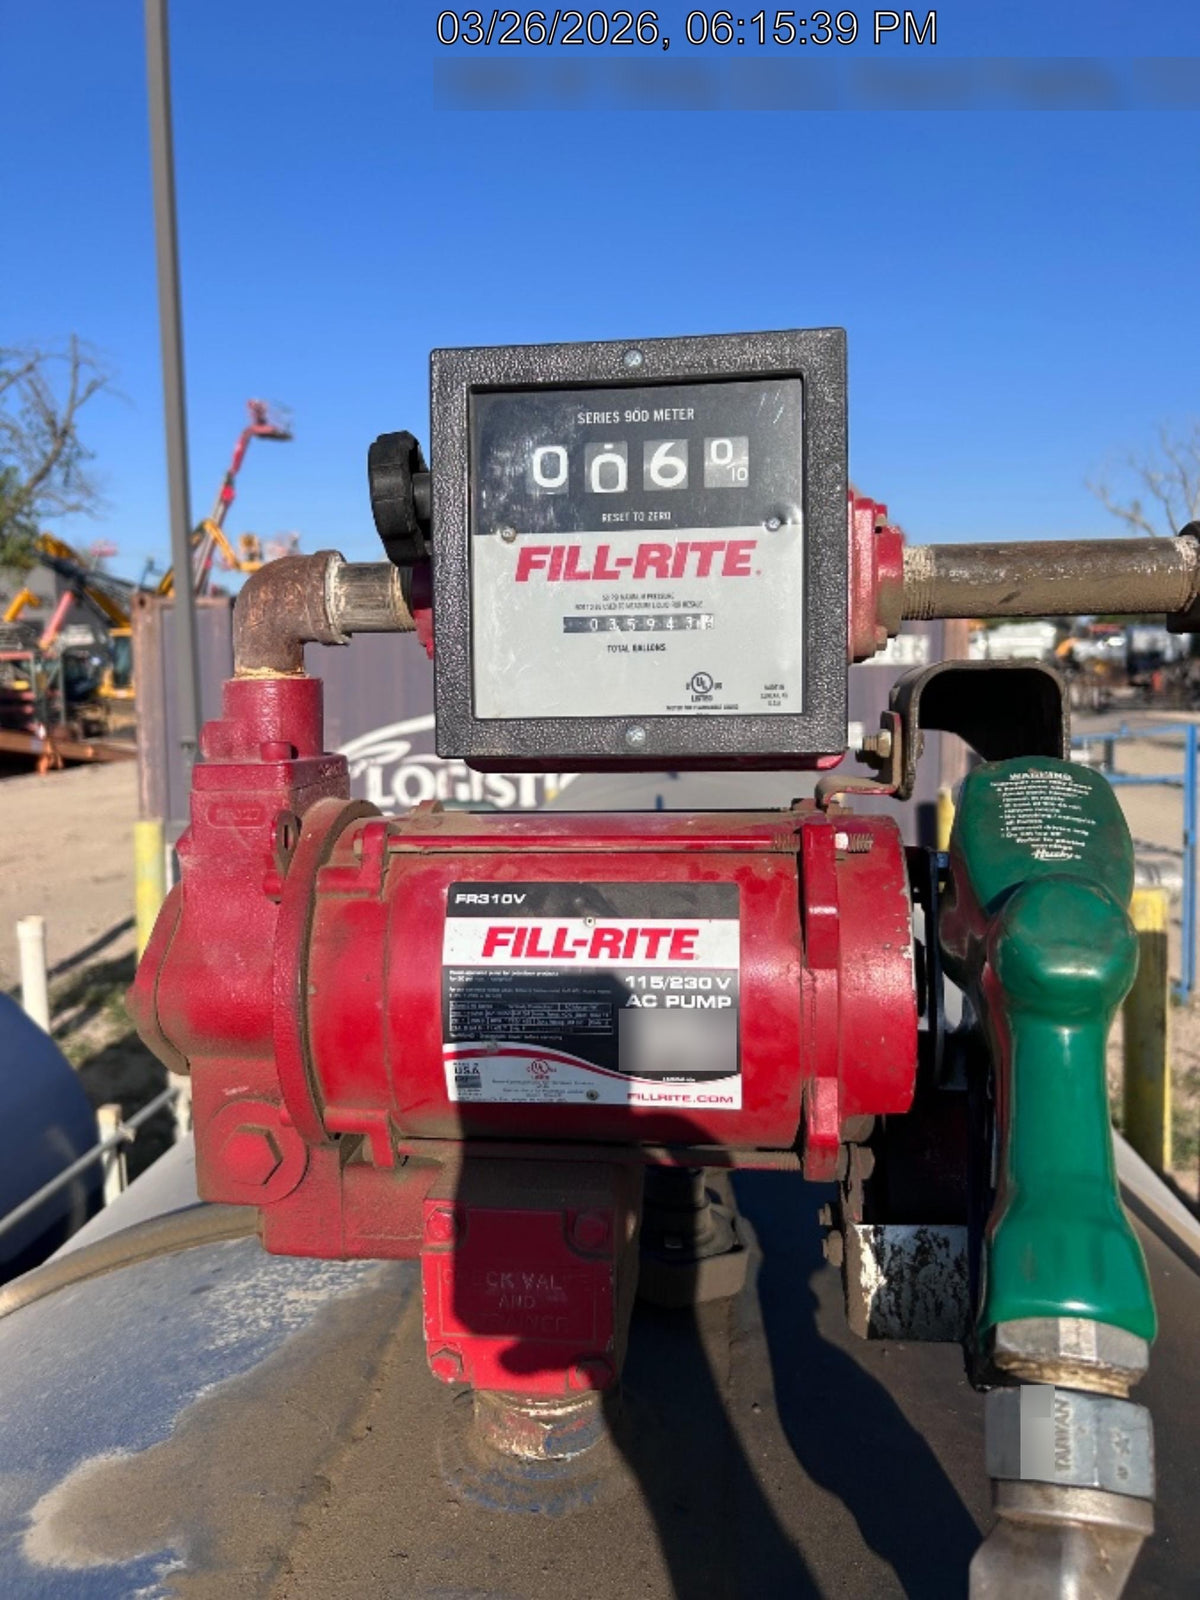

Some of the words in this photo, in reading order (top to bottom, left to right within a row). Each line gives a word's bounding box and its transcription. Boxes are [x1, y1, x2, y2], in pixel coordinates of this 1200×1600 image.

[577, 411, 620, 424] SERIES
[625, 410, 650, 422] 900
[653, 408, 695, 421] METER
[601, 511, 628, 522] RESET
[633, 511, 645, 522] TO
[648, 510, 671, 521] ZERO
[515, 540, 757, 582] FILL-RITE
[607, 644, 630, 653] TOTAL
[455, 893, 527, 905] FR310V
[481, 926, 700, 961] FILL-RITE
[625, 975, 711, 990] 115/230
[716, 977, 732, 990] V
[625, 995, 658, 1008] AC
[665, 995, 732, 1008] PUMP
[626, 1093, 734, 1104] FILLRITE.COM
[499, 1294, 536, 1310] AND
